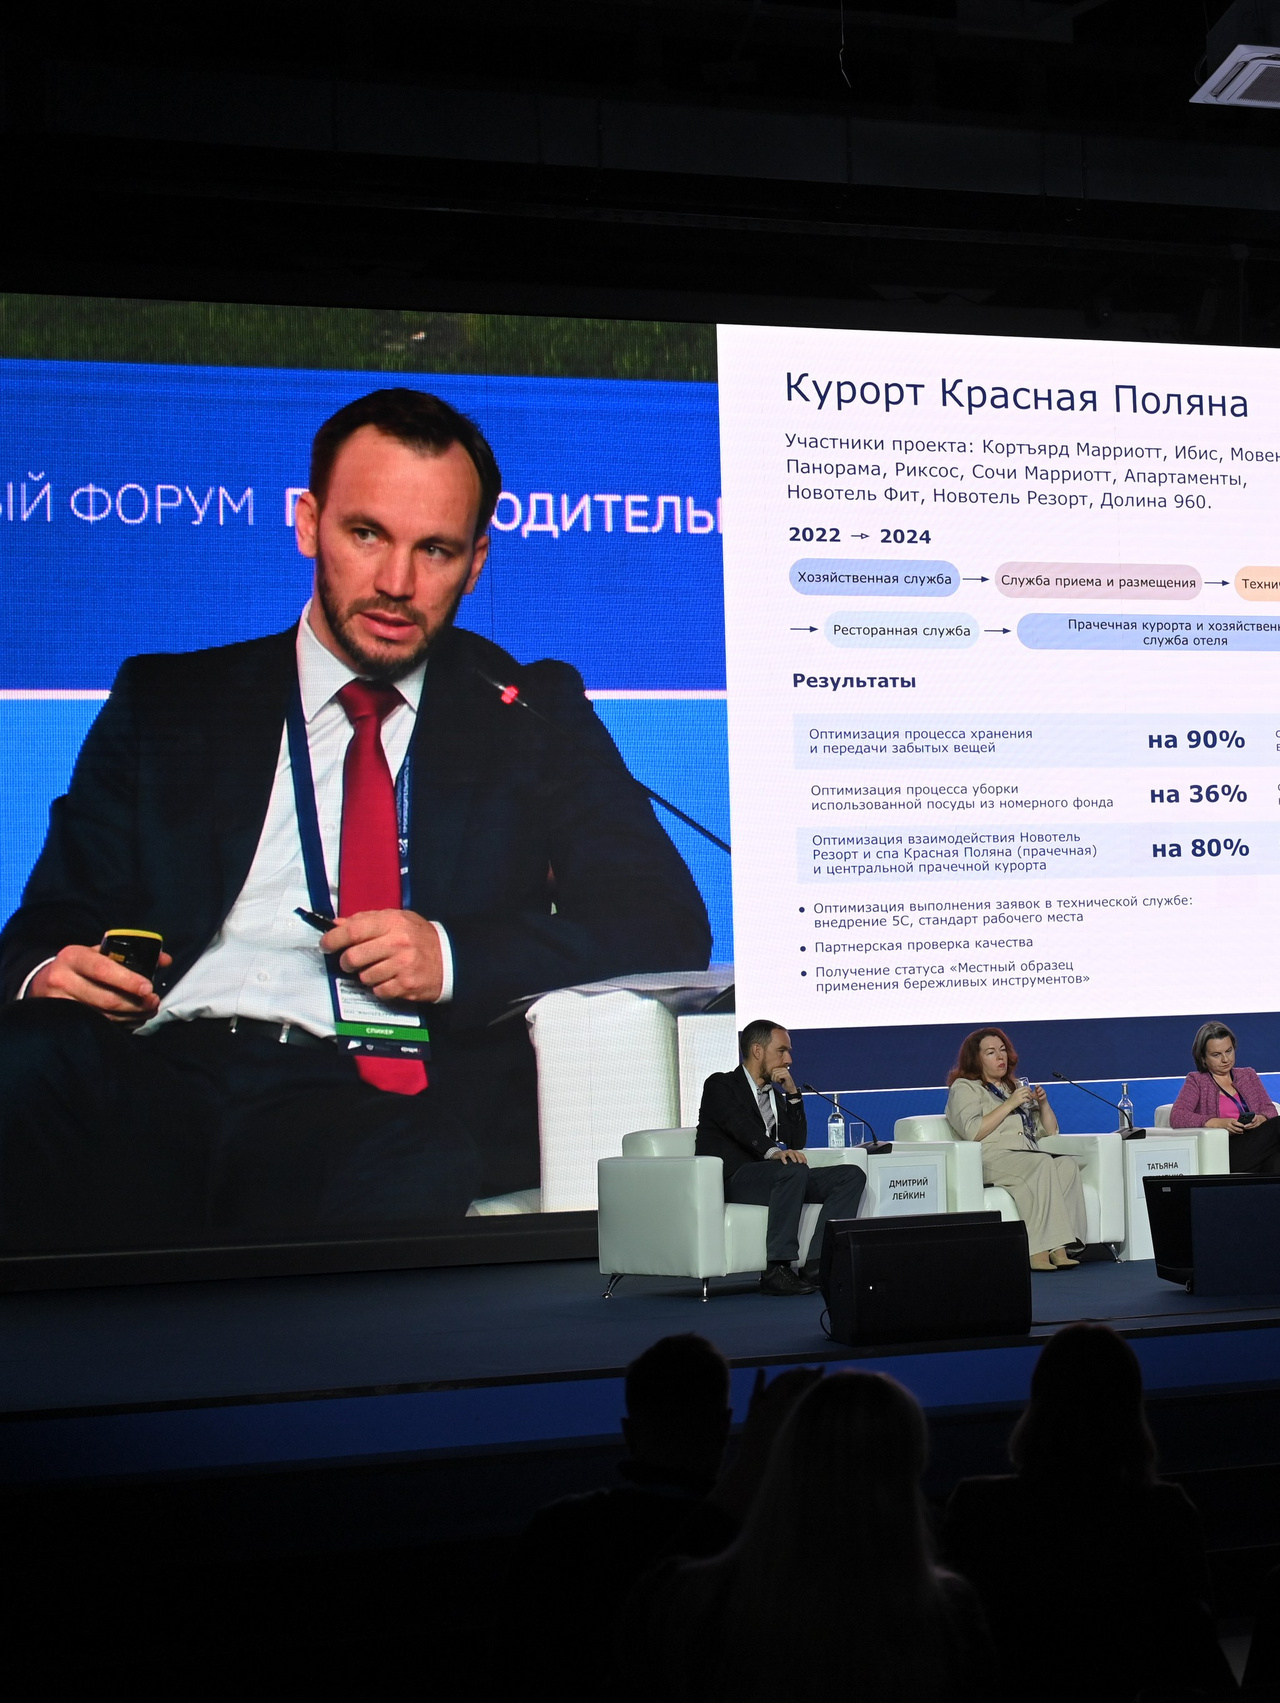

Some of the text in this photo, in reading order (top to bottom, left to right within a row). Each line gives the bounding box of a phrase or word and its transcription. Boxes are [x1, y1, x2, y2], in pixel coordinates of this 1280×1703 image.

[787, 372, 1247, 417] Курорт Красная Поляна
[785, 433, 884, 450] Участники
[892, 440, 973, 454] проекта:
[983, 439, 1070, 459] Кортъярд
[1077, 442, 1167, 462] Марриотт,
[1175, 445, 1224, 463] Ибис,
[787, 459, 1247, 488] Панорама, Риксос, Сочи Марриотт, Апартаменты,
[70, 482, 254, 525] ФОРУМ
[788, 484, 1211, 509] Новотель Фит, Новотель Резорт, Долина 960.
[789, 527, 931, 544] 2022 2024
[798, 571, 952, 586] Хозяйственная служба
[1001, 575, 1050, 588] Служба
[1055, 578, 1101, 588] приема
[1119, 578, 1196, 589] размещения
[834, 624, 970, 638] Ресторанная служба
[1068, 619, 1137, 632] Прачечная
[1142, 622, 1191, 633] курорта
[1196, 623, 1203, 631] и
[1143, 634, 1228, 647] служба отеля
[793, 673, 916, 691] Результаты
[809, 729, 1032, 741] Оптимизация процесса хранения
[1149, 730, 1245, 748] на 90%
[810, 742, 995, 756] и передачи забытых вещей
[811, 783, 1018, 797] Оптимизация процесса уборки
[1151, 784, 1247, 803] на 36%
[812, 797, 1113, 811] использованной посуды из номерного фонда
[812, 832, 1080, 846] Оптимизация взаимодействия Новотель
[1153, 838, 1249, 857] на 80%
[813, 845, 1097, 862] Резорт и спа Красная Поляна (прачечная)
[814, 860, 1046, 876] и центральной прачечной курорта
[814, 895, 1192, 914] Оптимизация выполнения заявок в технической службе:
[815, 918, 887, 930] внедрение
[919, 916, 978, 927] стандарт
[983, 913, 1042, 926] рабочего
[1048, 913, 1083, 922] места
[815, 938, 1033, 955] Партнерская проверка качества
[816, 960, 1074, 979] Получение статуса «Местный образец
[816, 975, 1090, 994] применения бережливых инструментов»
[1146, 1161, 1179, 1171] ТАТЬЯНА
[888, 1176, 929, 1189] ДМИТРИЙ
[892, 1190, 926, 1201] ЛЕЙКИН
